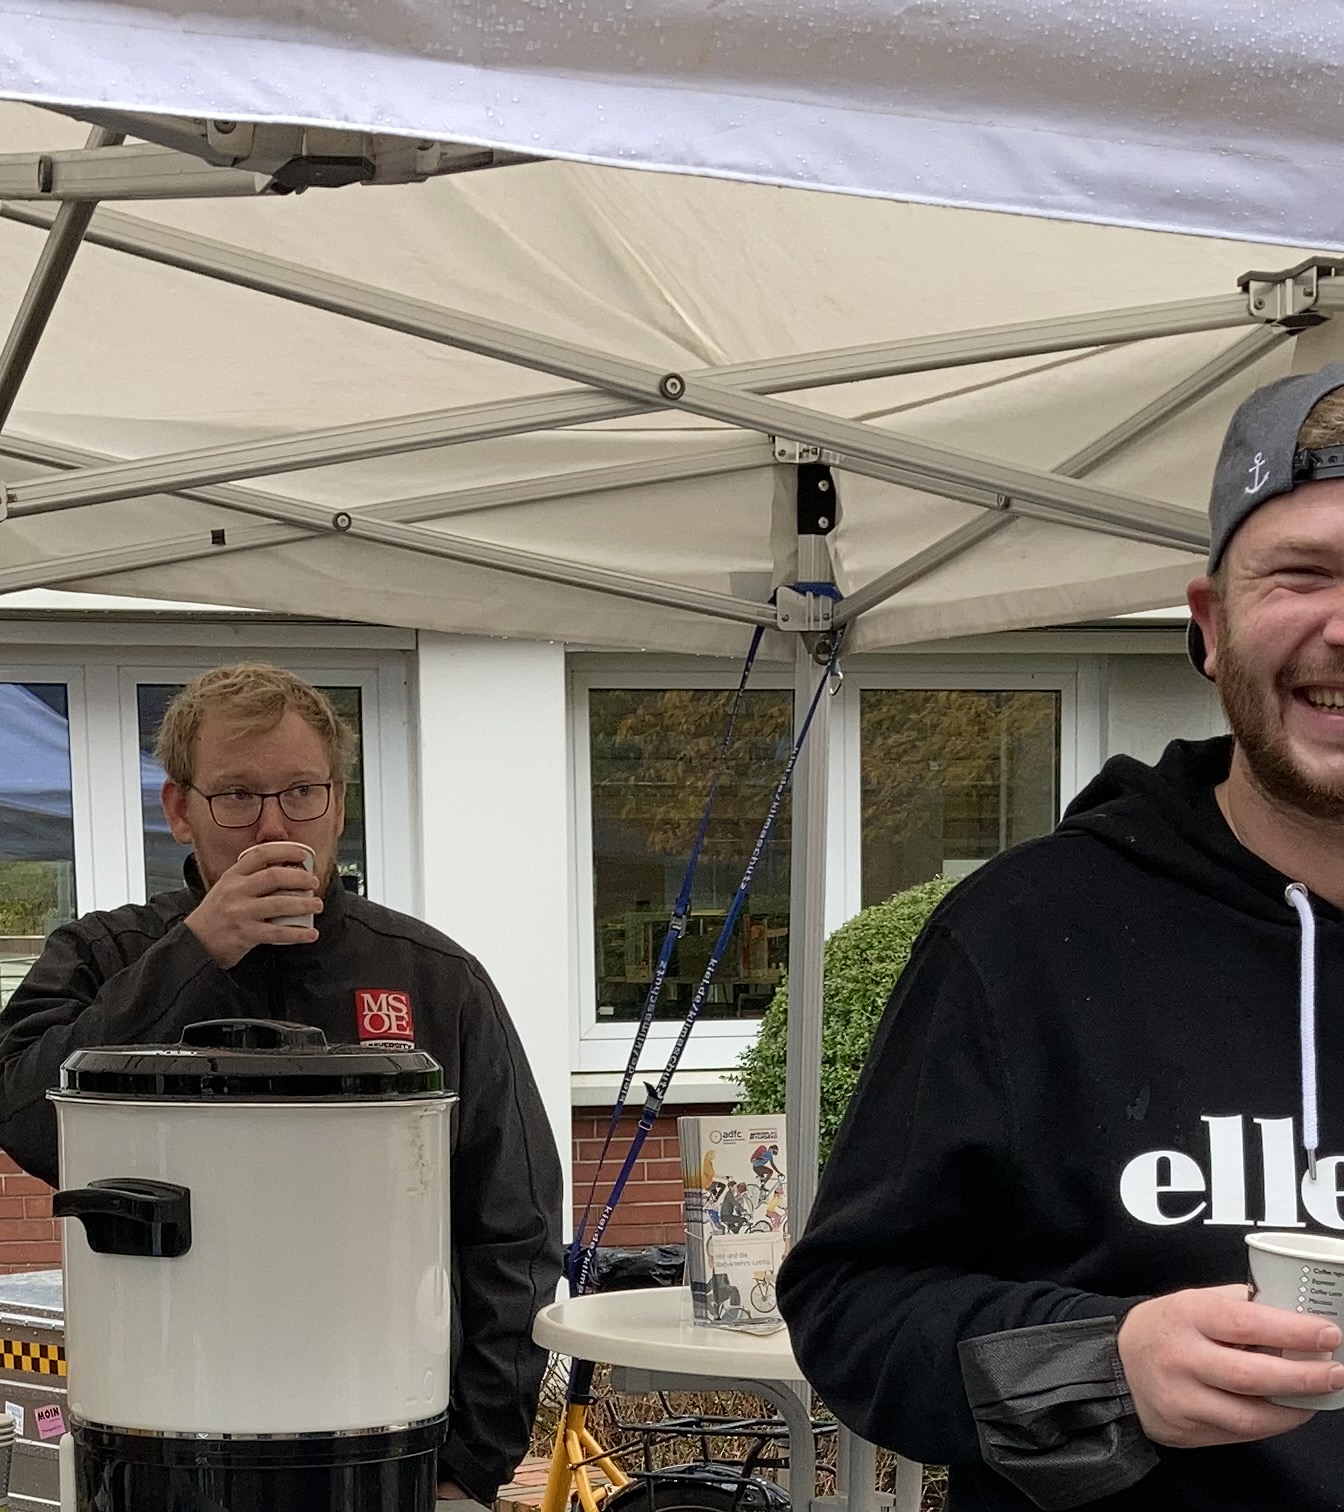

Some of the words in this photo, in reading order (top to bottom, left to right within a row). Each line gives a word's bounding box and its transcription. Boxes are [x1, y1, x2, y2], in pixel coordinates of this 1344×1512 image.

[656, 957, 719, 1100] kiel.de/klimaschutz
[722, 1129, 742, 1139] adfc
[37, 1407, 60, 1421] MOIN
